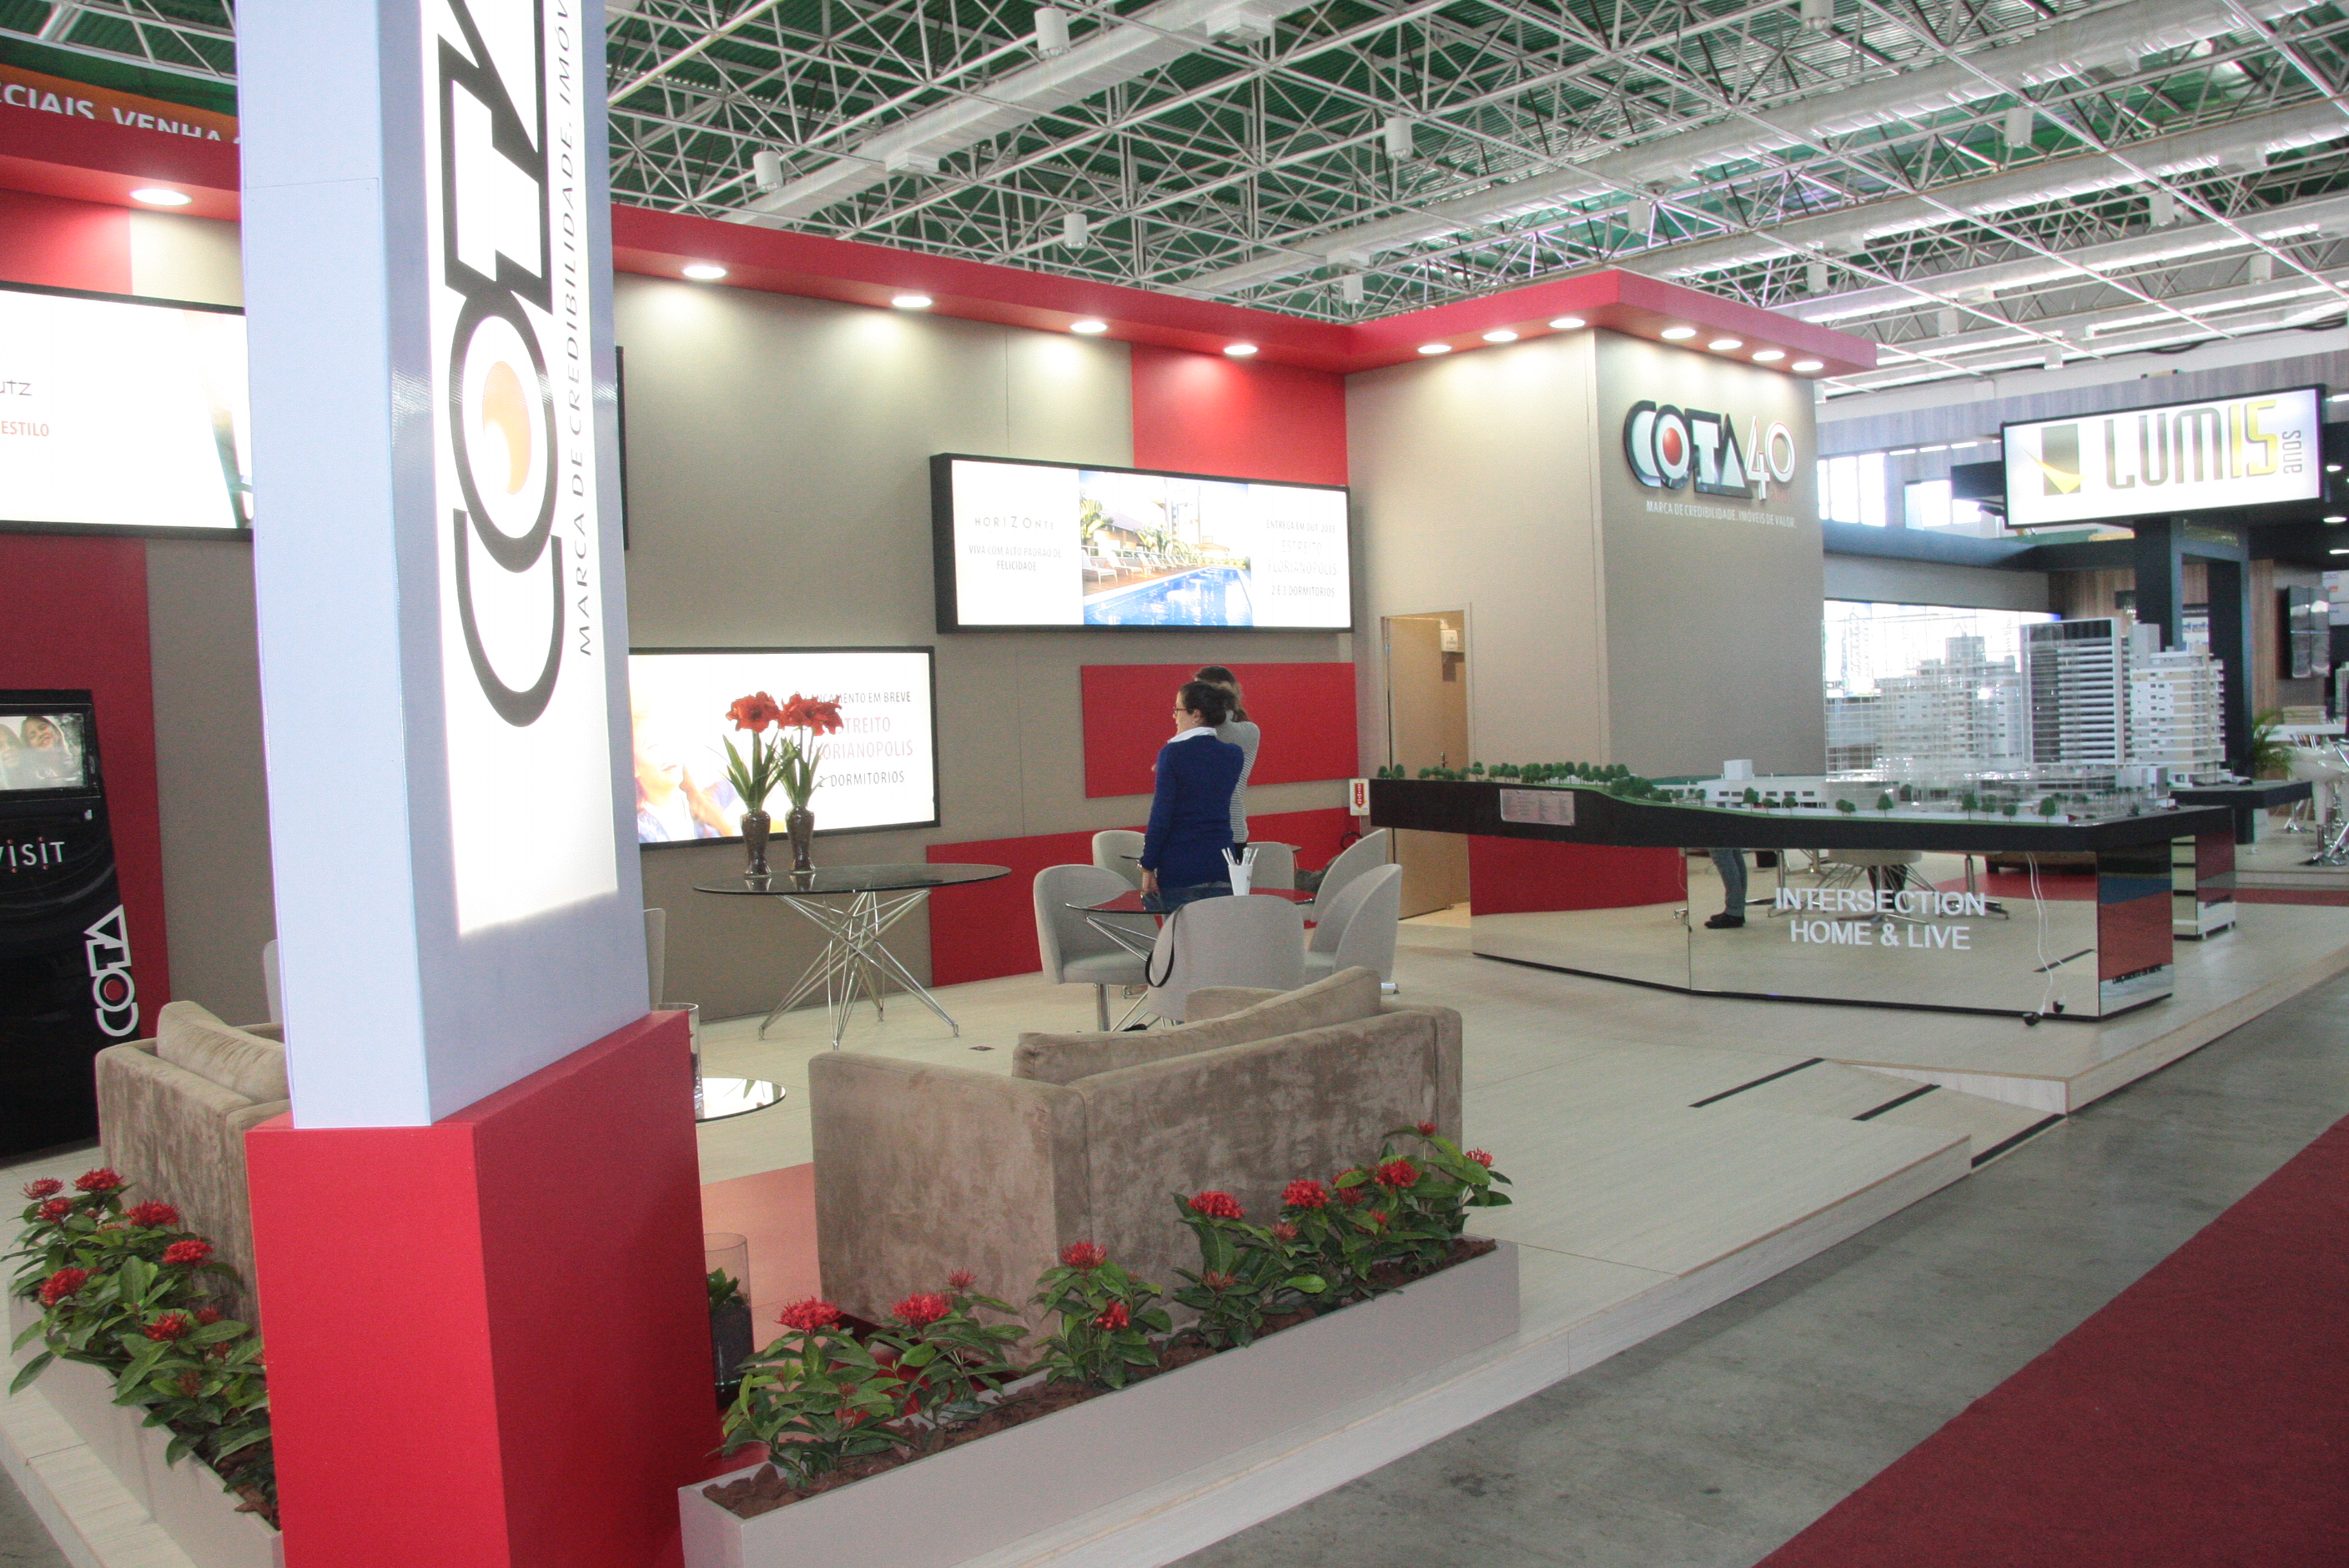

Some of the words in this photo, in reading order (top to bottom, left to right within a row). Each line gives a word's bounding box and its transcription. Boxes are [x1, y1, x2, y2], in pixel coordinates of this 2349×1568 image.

[0, 82, 95, 120] CIAIS
[559, 121, 583, 436] CREDIBILIDADE.
[2, 420, 49, 437] ESTILO
[2281, 430, 2303, 475] anos
[571, 448, 584, 498] DE
[974, 515, 1054, 530] HORIZONTE
[1646, 500, 1673, 515] MARCA
[1674, 503, 1684, 516] DE
[1765, 513, 1775, 525] DE
[1266, 519, 1295, 530] ENTREGA
[1295, 521, 1305, 531] EM
[1306, 522, 1318, 532] OUT
[968, 545, 986, 555] VIVA
[987, 545, 1003, 555] COM
[1005, 546, 1022, 556] ALTO
[1053, 548, 1062, 558] DE
[1281, 540, 1322, 555] ESTREITO
[997, 560, 1037, 571] FELICIDADE
[573, 511, 591, 657] MARCA
[1270, 585, 1275, 596] 2
[868, 692, 882, 703] EM
[883, 691, 911, 703] BREVE
[1775, 887, 1986, 917] INTERSECTION
[1790, 920, 1873, 946] HOME
[1879, 922, 1900, 947] &
[1907, 923, 1971, 950] LIVE
[84, 904, 139, 1037] COTA
